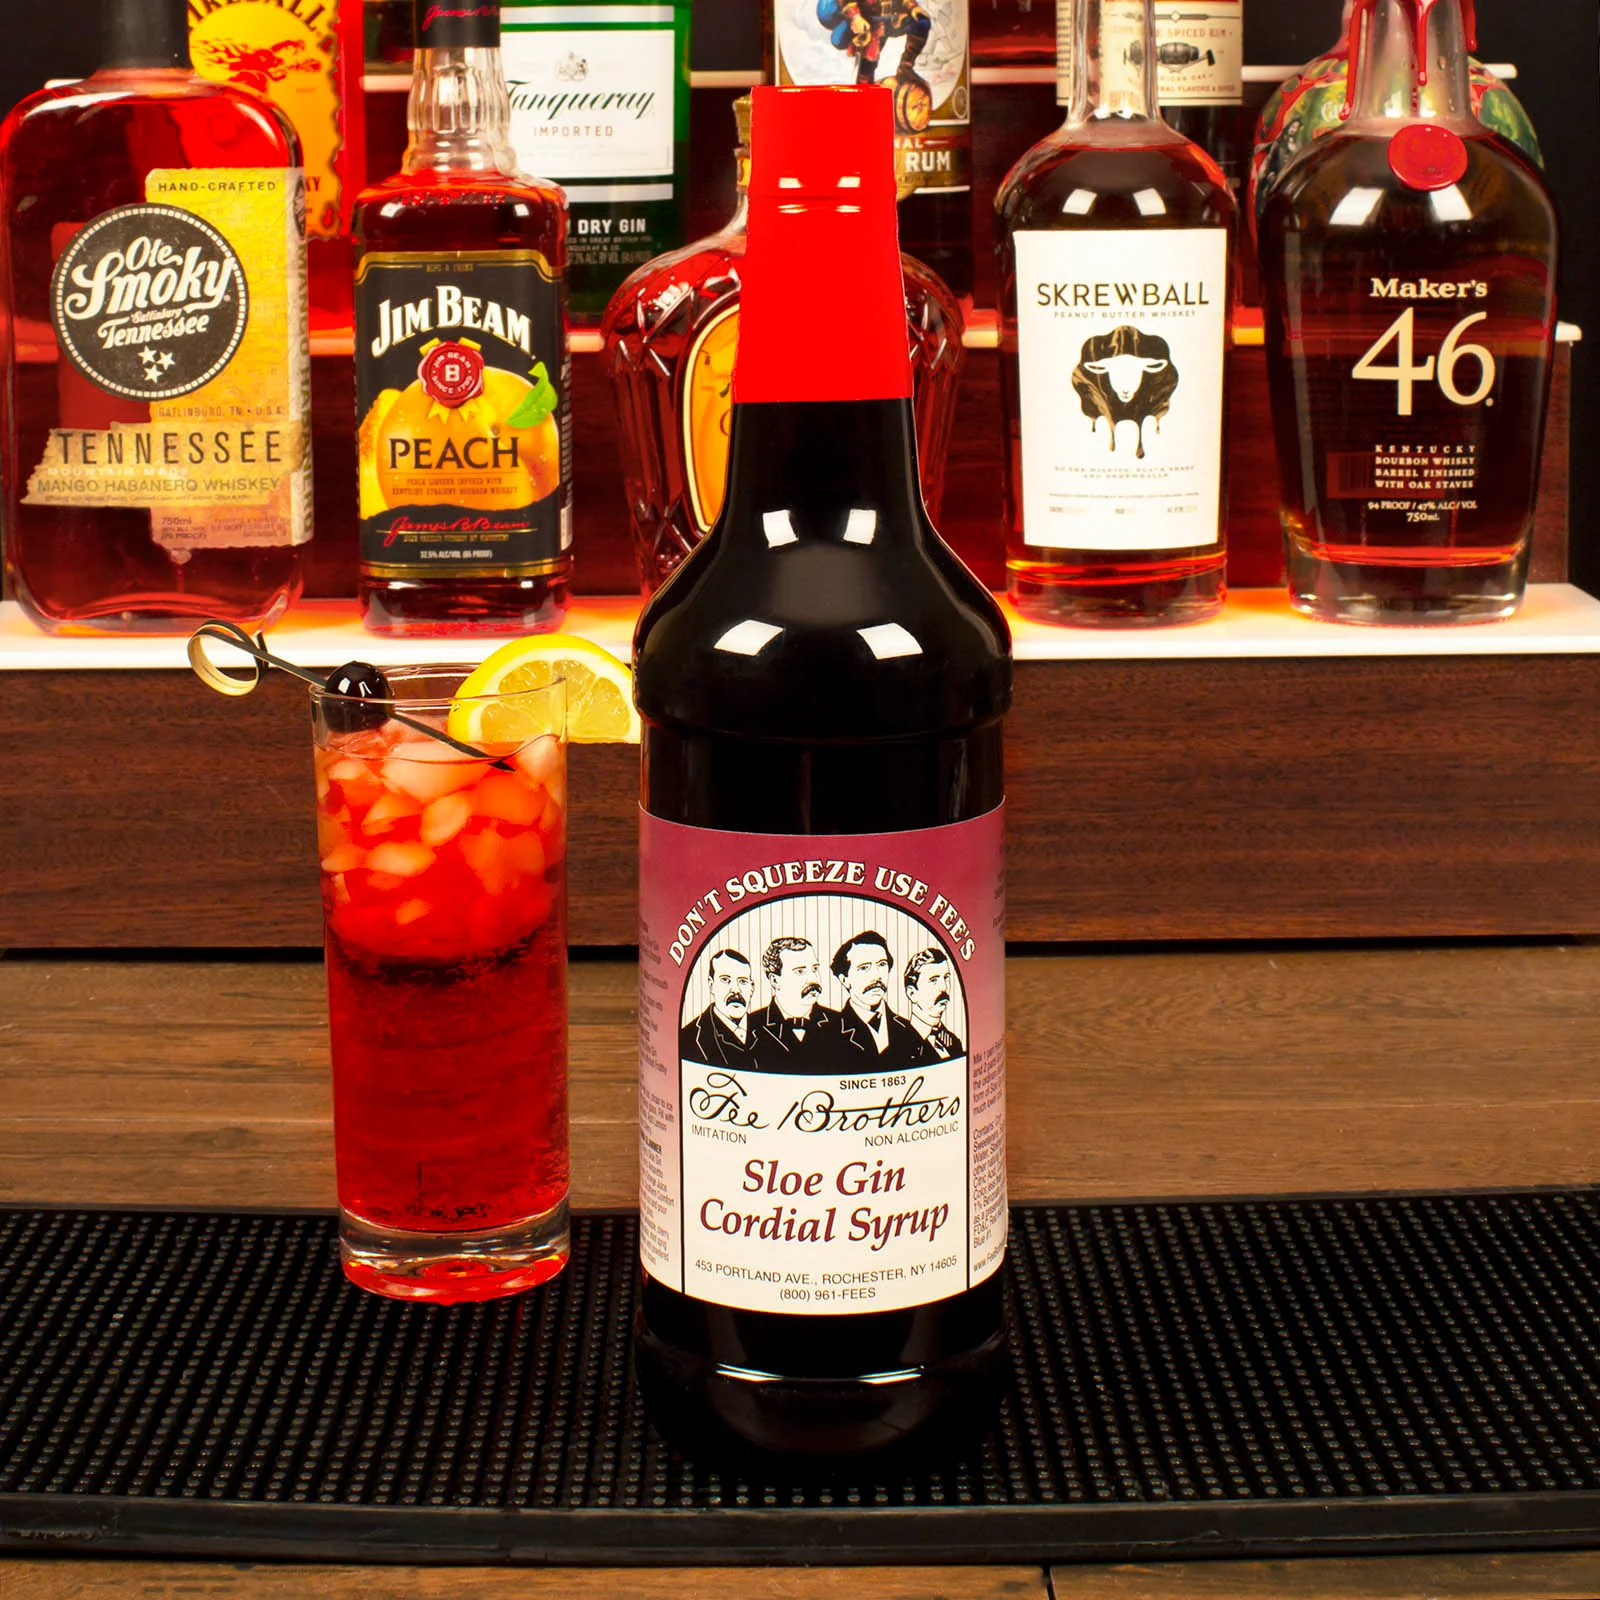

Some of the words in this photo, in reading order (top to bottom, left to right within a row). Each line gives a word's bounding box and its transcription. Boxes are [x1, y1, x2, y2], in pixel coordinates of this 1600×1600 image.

[505, 79, 656, 121] Tanqueray
[533, 125, 614, 137] IMPORTED
[905, 150, 952, 172] RUM
[157, 180, 277, 193] HAND-CRAFTED
[577, 218, 612, 235] DRY
[618, 217, 647, 233] GIN
[125, 235, 183, 271] Ole
[63, 246, 236, 321] Smoky
[1036, 281, 1209, 307] SKREWBALL
[1369, 277, 1488, 299] Maker's
[371, 298, 434, 359] JIM
[435, 284, 532, 355] BEAM
[1053, 310, 1096, 319] PEANUT
[1101, 310, 1146, 319] BUTTER
[1151, 309, 1197, 318] WHISKEY
[97, 313, 210, 350] Tennessee
[445, 363, 460, 382] B
[56, 429, 282, 465] TENNESSEE
[388, 436, 520, 470] PEACH
[1375, 444, 1477, 454] KENTUCKY
[1375, 456, 1429, 466] BOURBON
[1432, 456, 1476, 466] WHISKY
[1374, 479, 1405, 489] WITH
[1407, 480, 1432, 489] OAK
[1435, 480, 1475, 489] STAVES
[1375, 468, 1420, 477] BARREL
[1423, 468, 1476, 478] FINISHED
[36, 478, 100, 494] MANGO
[103, 477, 199, 493] HABANERO
[203, 476, 281, 492] WHISKEY
[1367, 500, 1380, 510] 94
[1380, 500, 1411, 510] PROOF
[668, 890, 723, 968] DON'T
[725, 858, 866, 903] SQUEEZE
[873, 864, 930, 905] USE
[927, 893, 977, 962] FEE'S
[839, 1078, 877, 1091] SINCE
[881, 1075, 907, 1088] 1863
[689, 1071, 770, 1129] Fee
[777, 1075, 961, 1133] Brothers
[691, 1122, 748, 1145] IMITATION
[863, 1134, 893, 1148] NON
[896, 1121, 960, 1145] ALCOHOLIC
[742, 1158, 823, 1197] Sloe
[836, 1159, 906, 1197] Gin
[699, 1197, 837, 1243] Cordial
[848, 1202, 950, 1252] Syrup
[694, 1258, 714, 1274] 453
[714, 1263, 782, 1284] PORTLAND
[784, 1272, 818, 1286] AVE.,
[821, 1267, 908, 1286] ROCHESTER,
[910, 1263, 927, 1278] NY
[929, 1255, 959, 1273] 14605
[779, 1288, 811, 1303] (800)
[813, 1286, 877, 1302] 961-FEES
